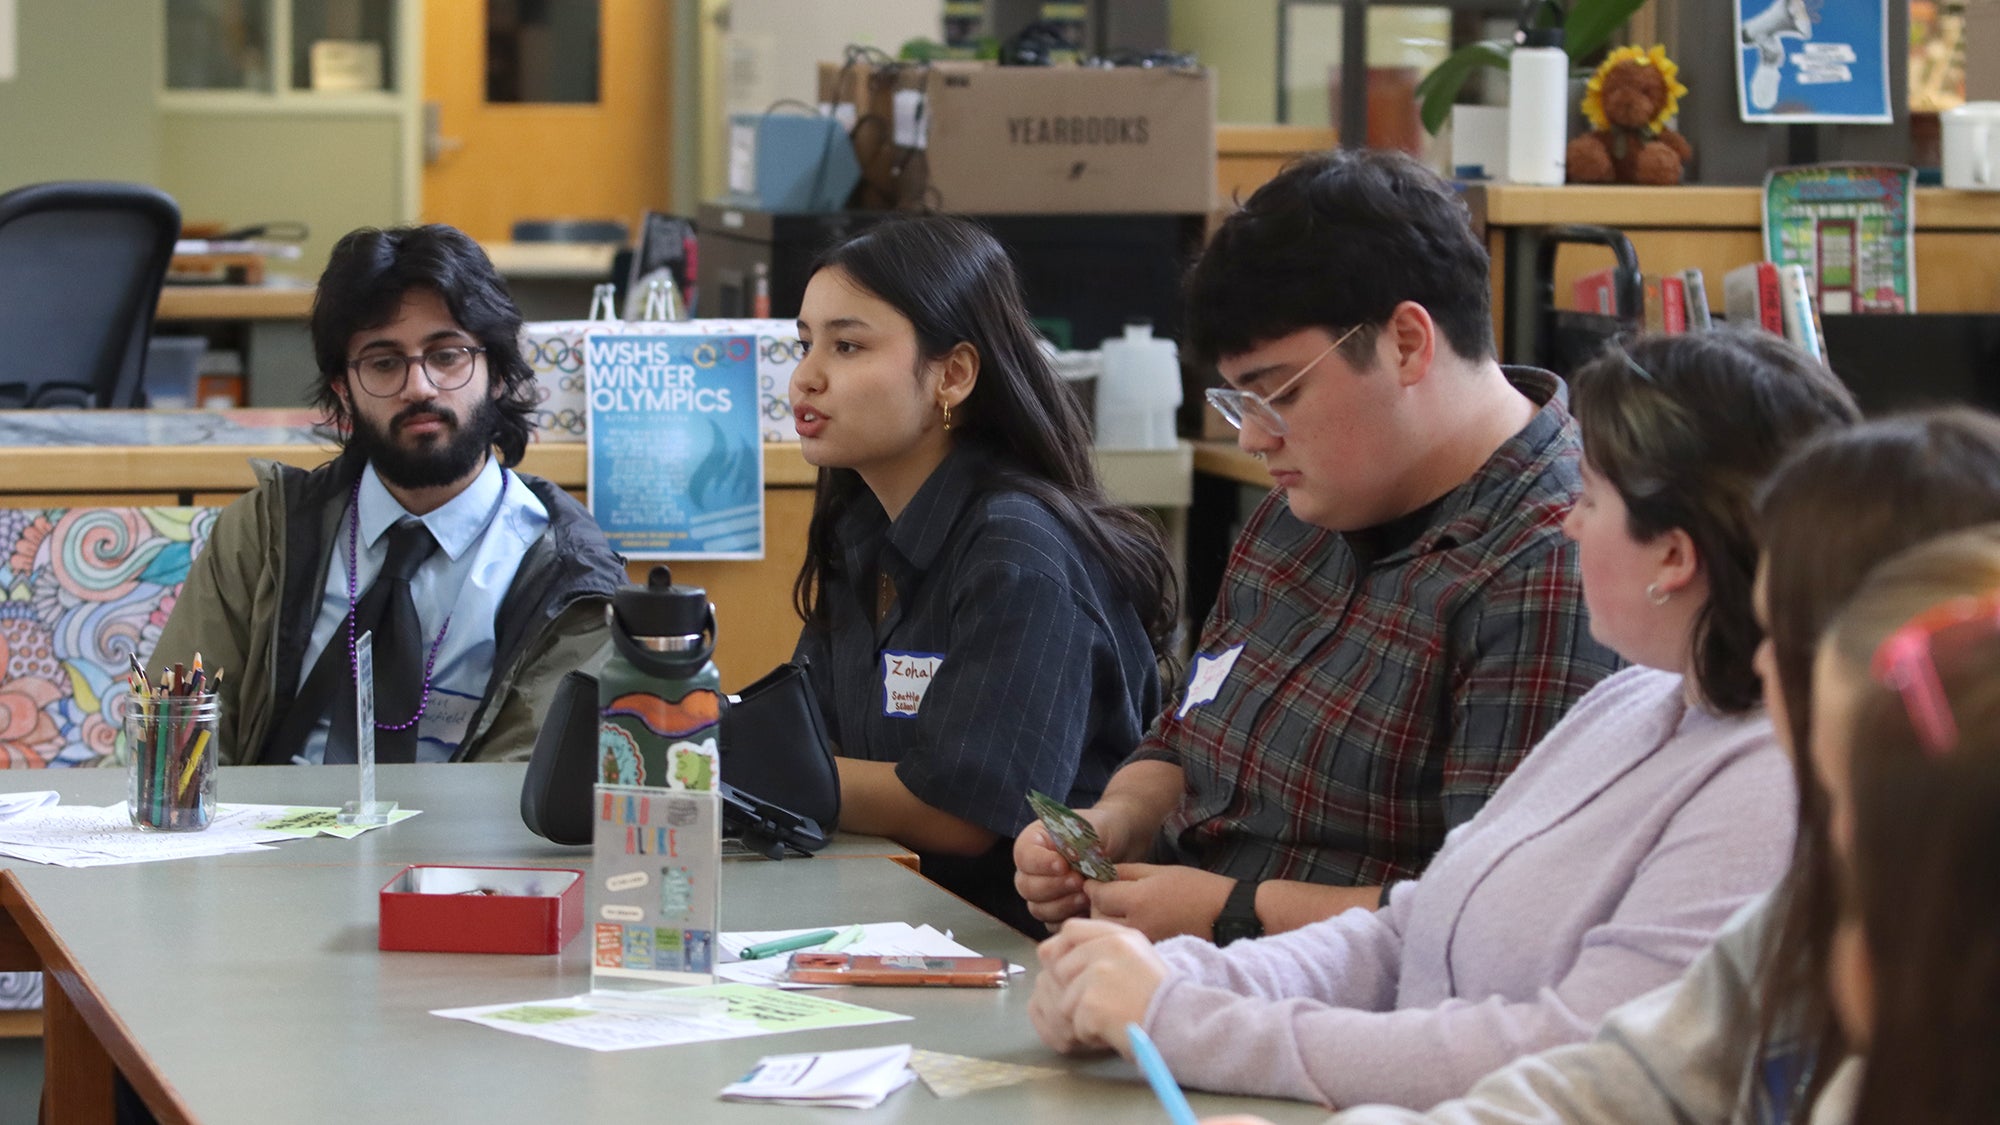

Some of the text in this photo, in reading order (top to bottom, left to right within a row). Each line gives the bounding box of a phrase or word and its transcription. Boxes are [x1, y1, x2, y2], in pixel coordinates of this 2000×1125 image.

[1008, 116, 1150, 145] YEARBOOKS
[590, 341, 670, 365] WSHS
[590, 365, 696, 389] WINTER
[591, 388, 733, 412] OLYMPICS
[892, 659, 933, 680] Zohal
[602, 793, 649, 825] READ
[625, 826, 677, 858] ALIKE
